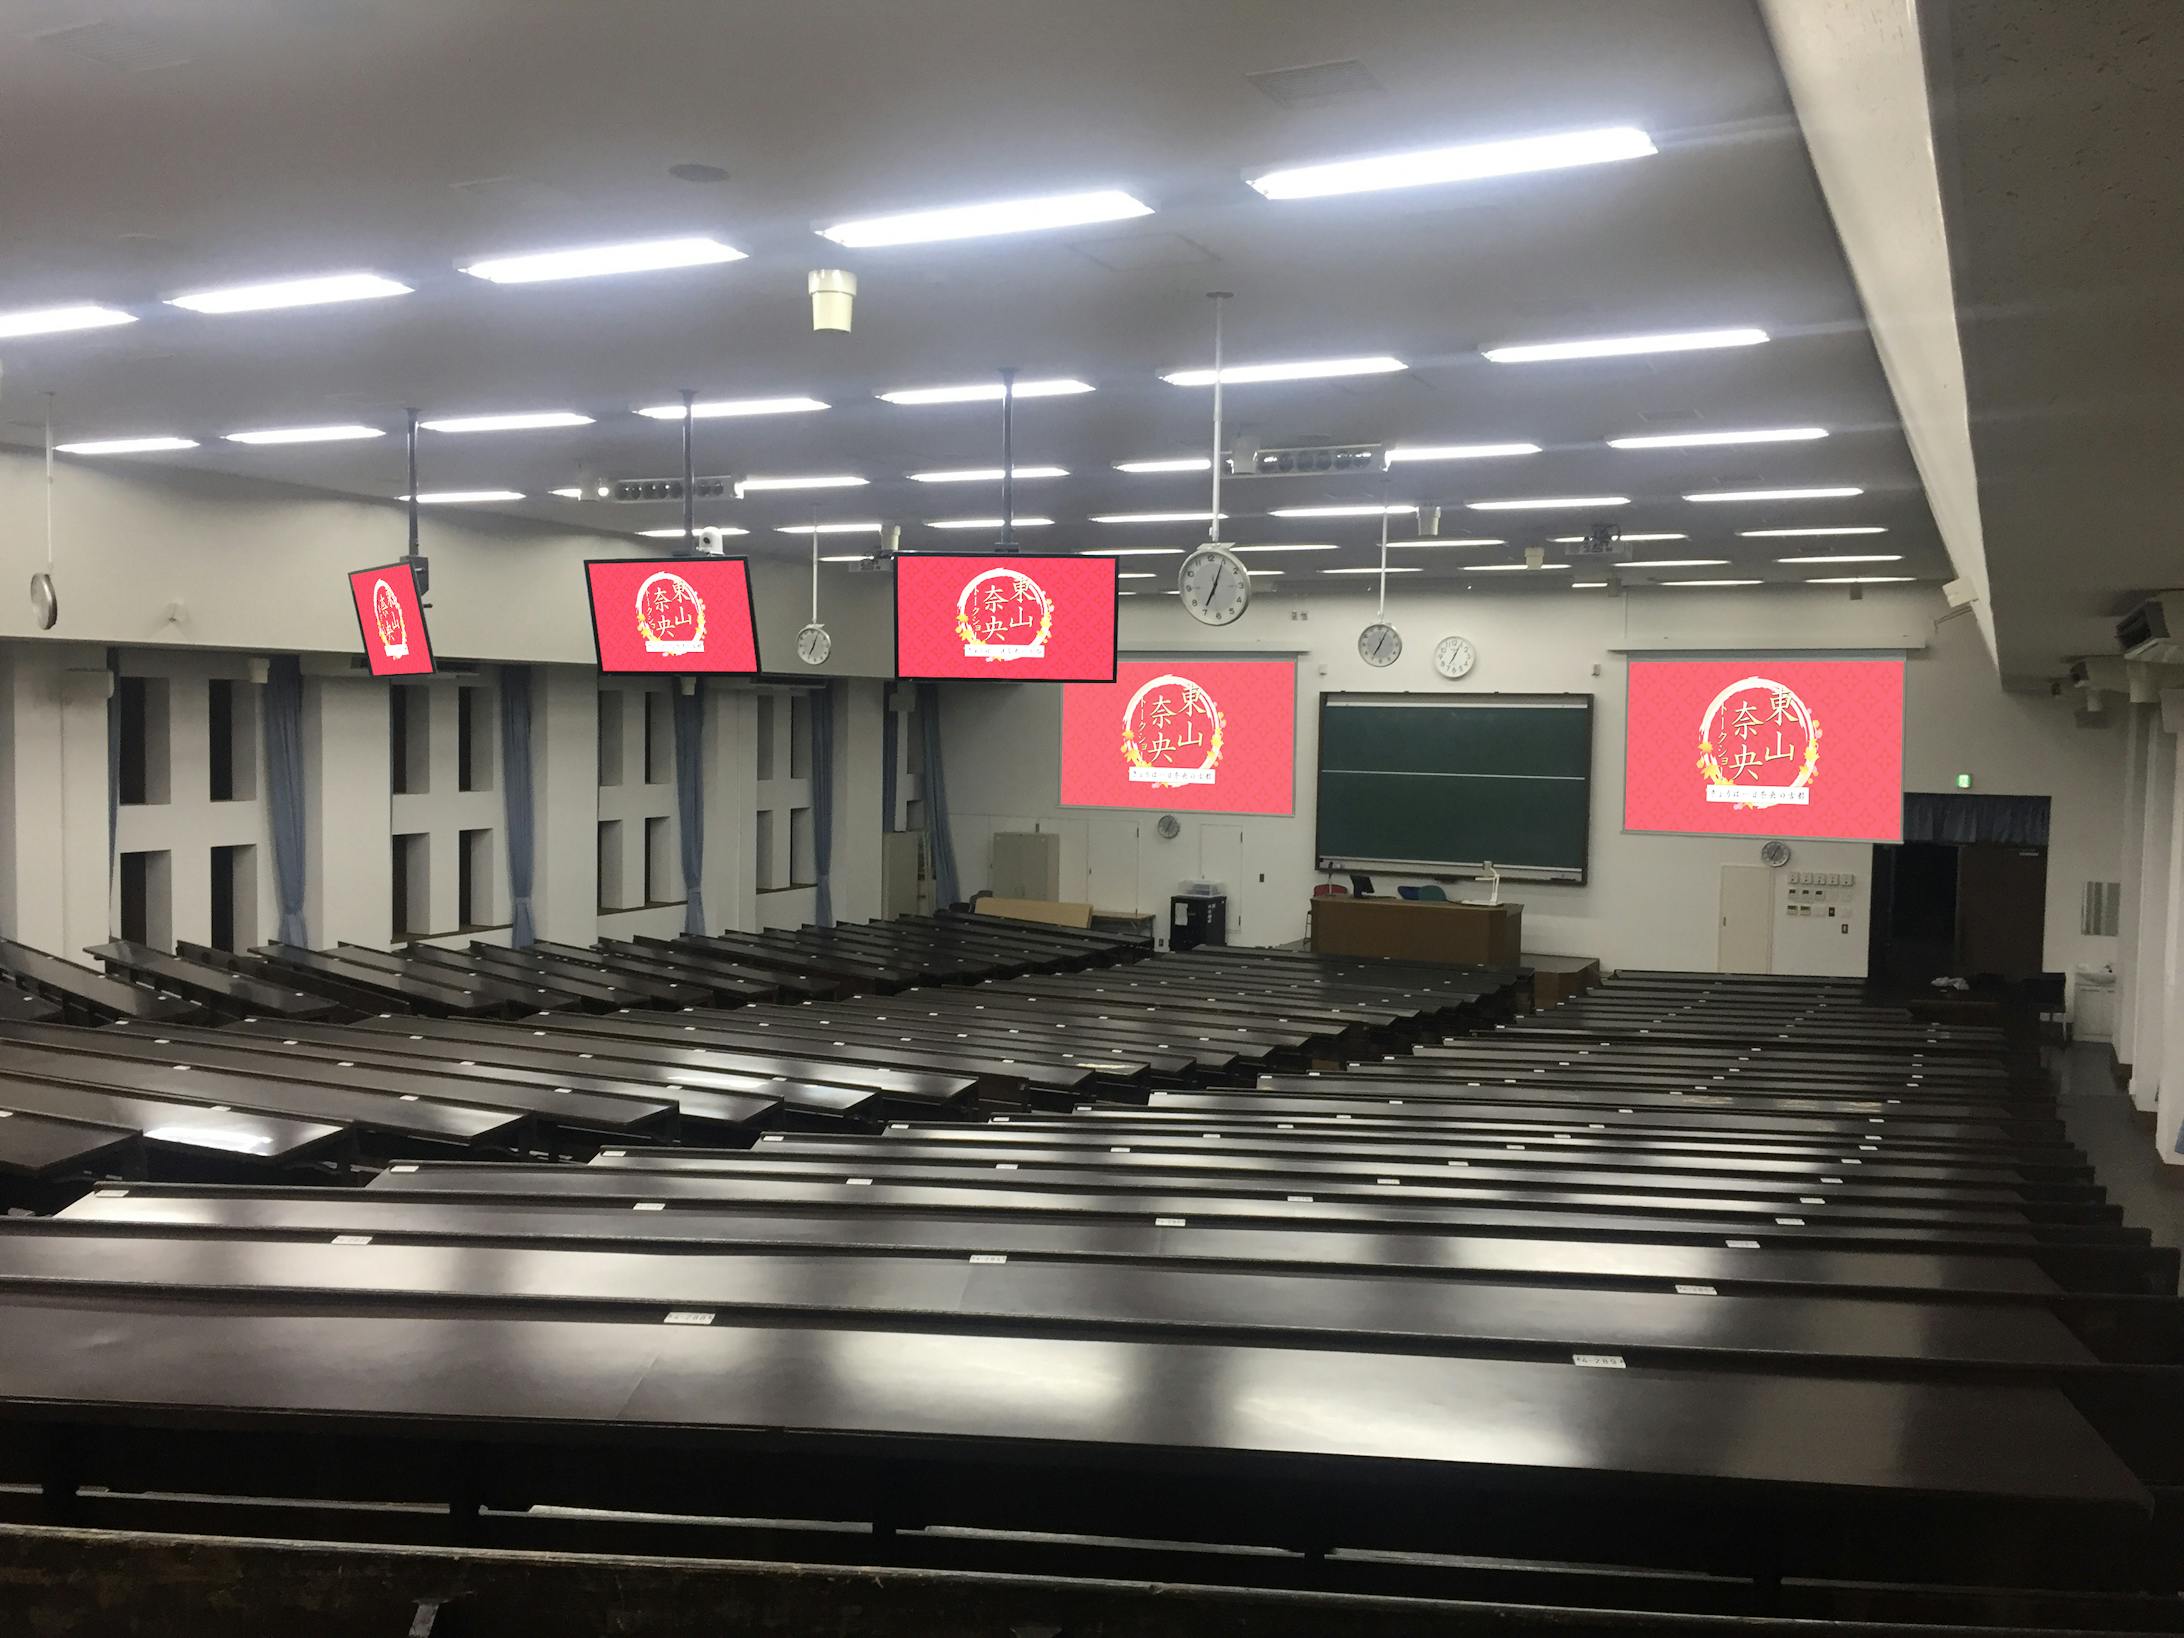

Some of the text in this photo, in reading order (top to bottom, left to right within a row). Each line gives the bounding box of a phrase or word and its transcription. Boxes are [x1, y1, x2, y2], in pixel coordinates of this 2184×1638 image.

[653, 586, 676, 638] 奈央
[672, 580, 692, 626] 東山
[982, 585, 1009, 641] 奈央
[1009, 576, 1036, 628] 東山
[1148, 694, 1178, 764] 奈央
[1177, 684, 1206, 748] 東山
[1717, 704, 1729, 781] トークショー
[1730, 701, 1764, 781] 奈央
[1764, 688, 1800, 762] 東山
